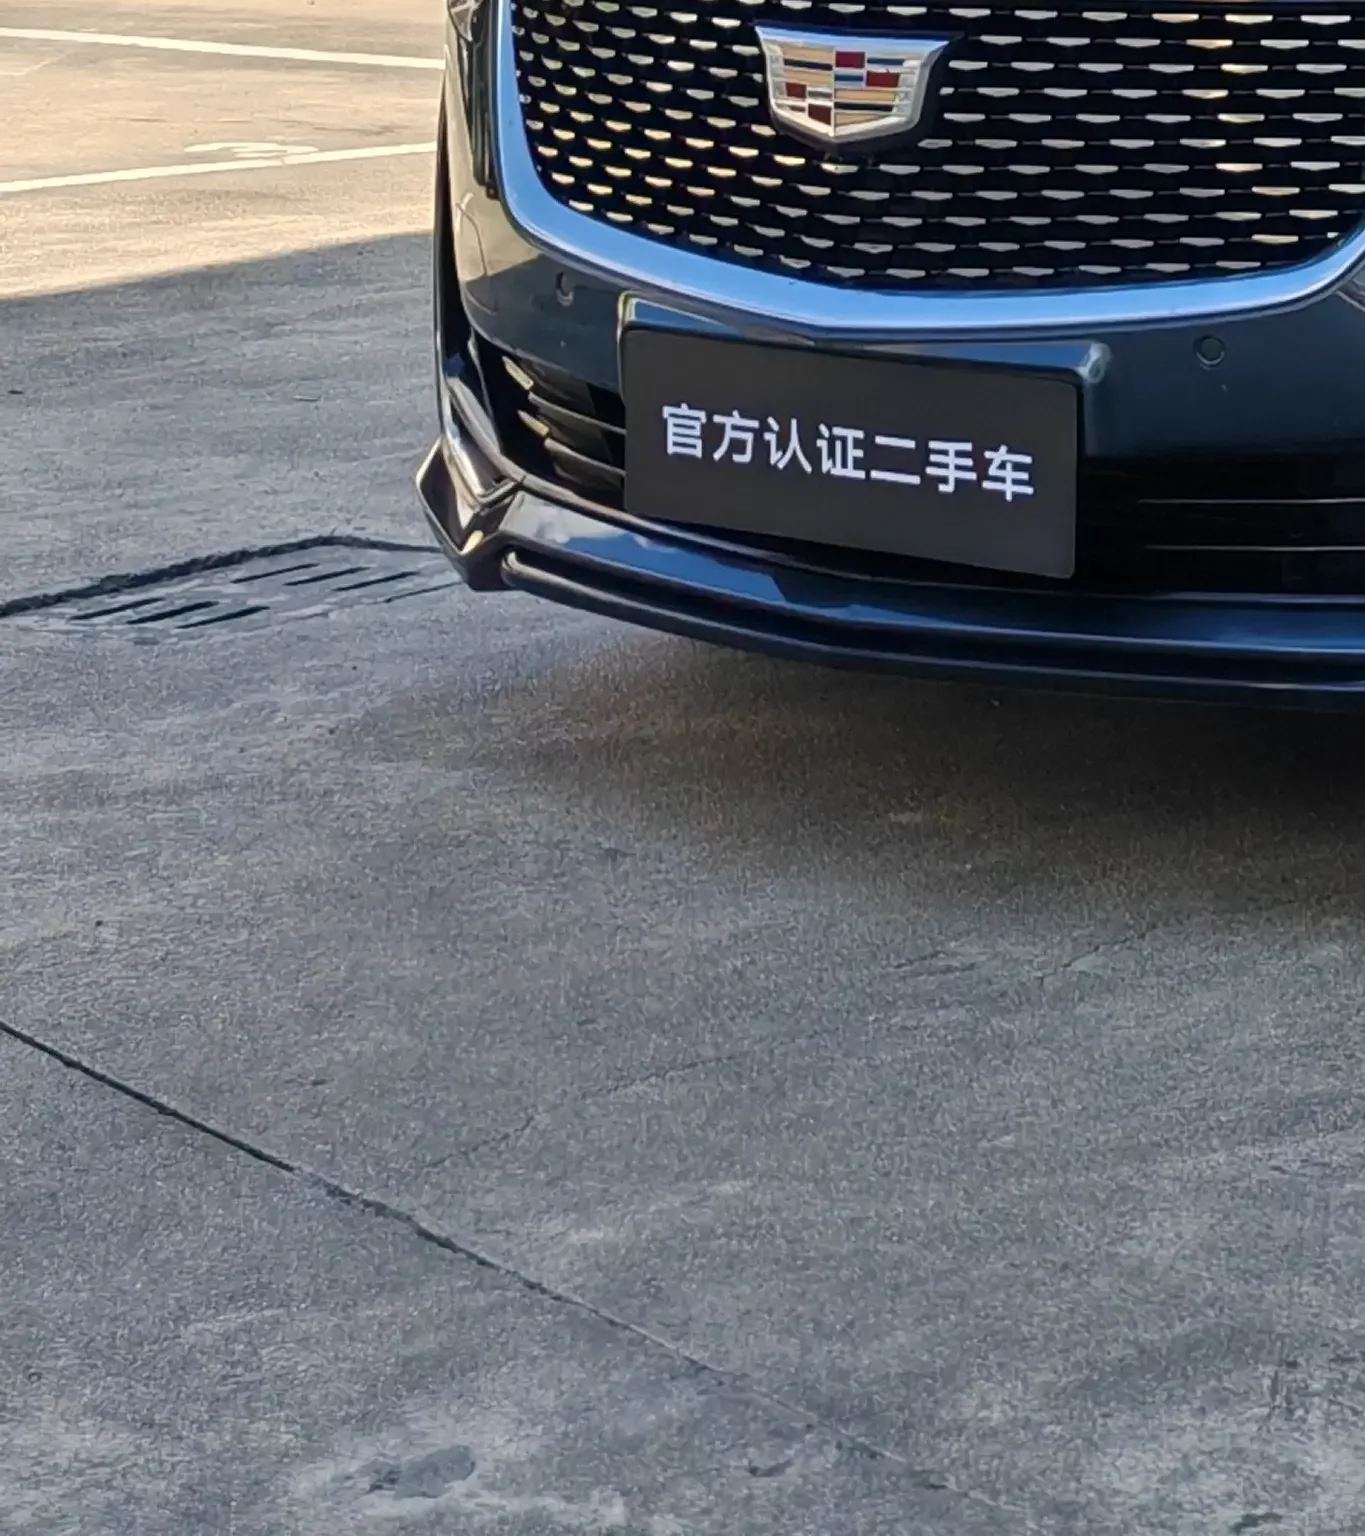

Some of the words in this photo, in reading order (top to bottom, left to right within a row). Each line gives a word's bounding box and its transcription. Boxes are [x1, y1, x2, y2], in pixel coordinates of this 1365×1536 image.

[661, 402, 1036, 503] 官方认证二手车
